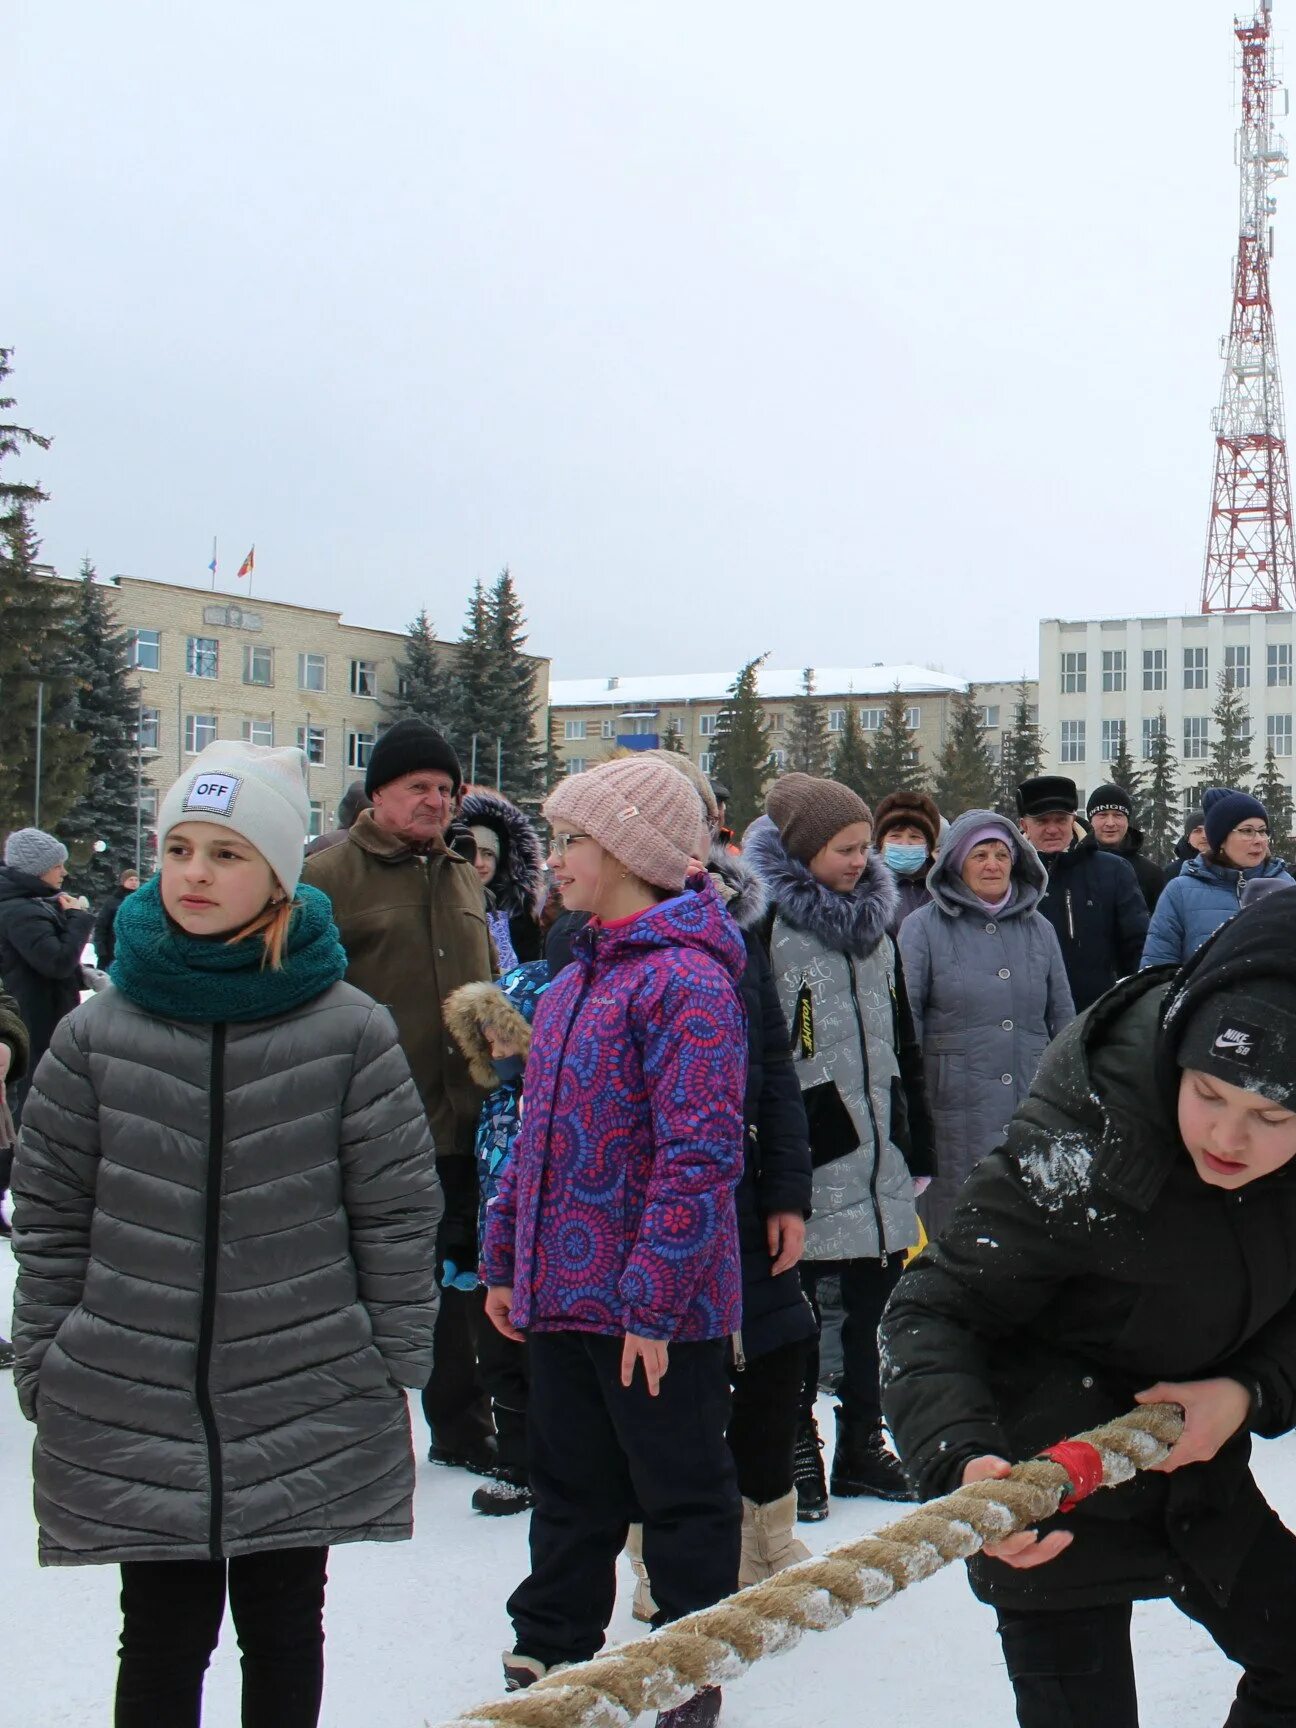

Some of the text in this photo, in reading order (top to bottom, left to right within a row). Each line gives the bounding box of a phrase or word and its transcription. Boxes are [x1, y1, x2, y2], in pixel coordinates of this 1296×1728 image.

[197, 783, 229, 797] OFF
[802, 998, 813, 1050] VOLUME
[1223, 1028, 1250, 1044] NIKE
[1235, 1045, 1251, 1056] SB
